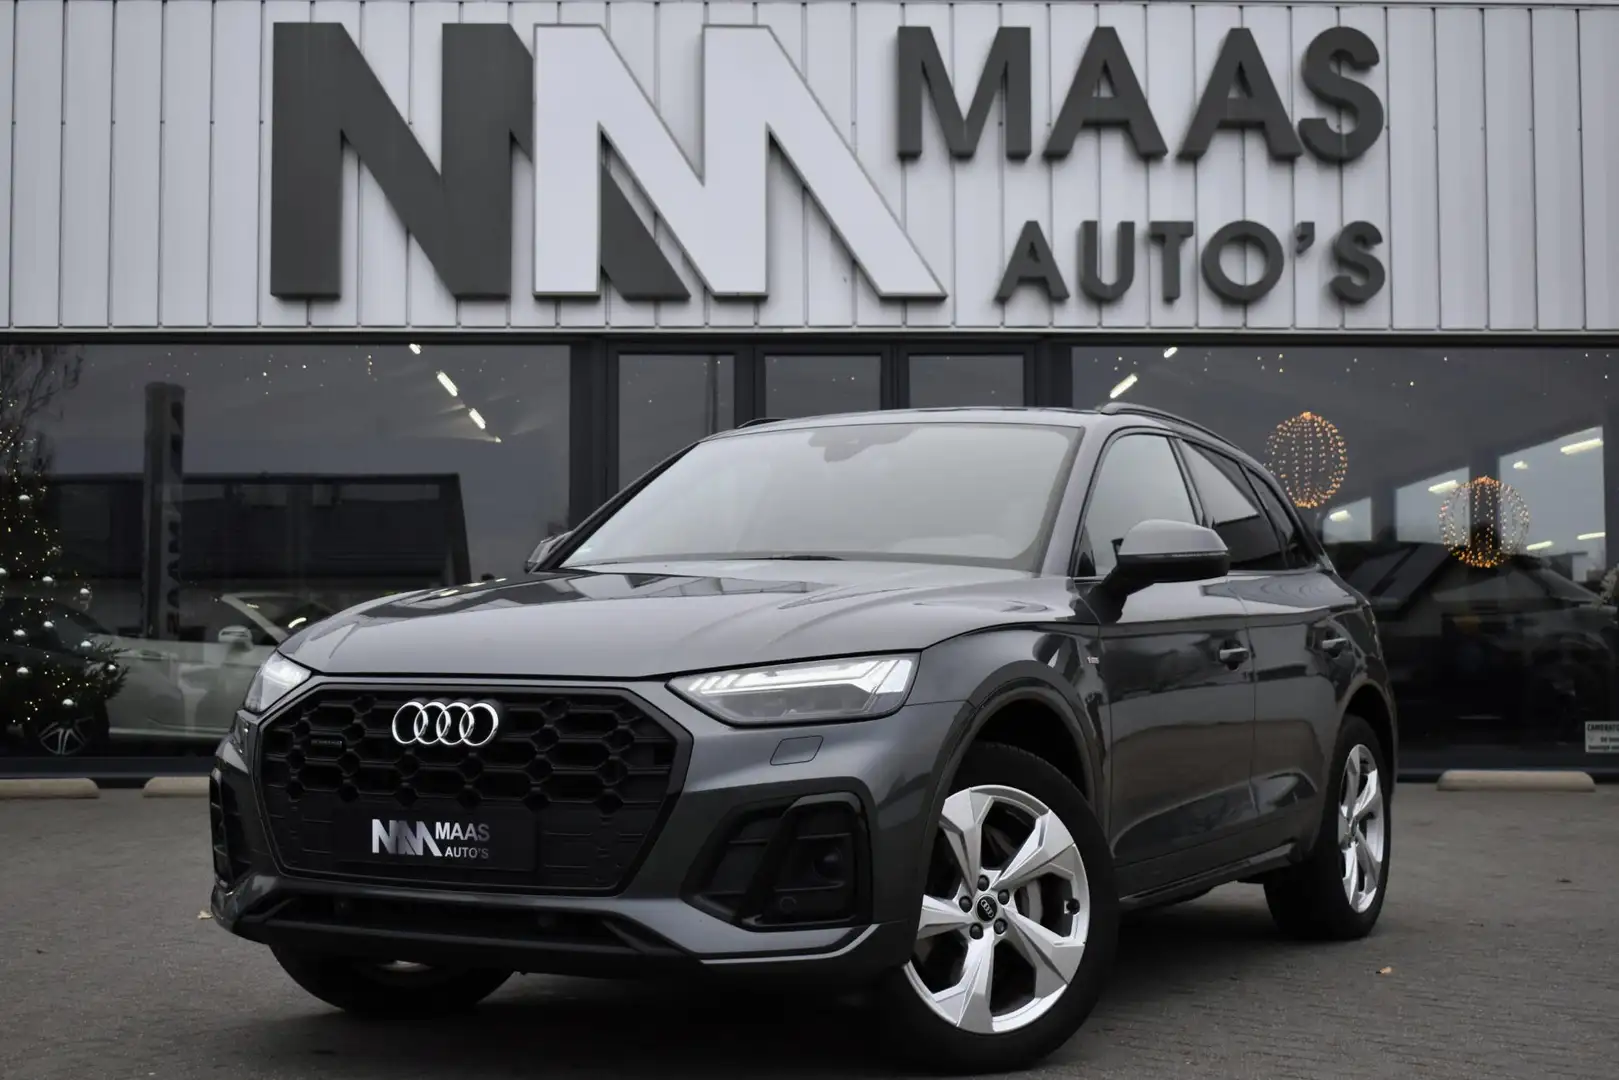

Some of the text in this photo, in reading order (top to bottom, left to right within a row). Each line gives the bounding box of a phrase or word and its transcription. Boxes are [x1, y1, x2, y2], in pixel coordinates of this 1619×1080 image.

[896, 25, 1384, 162] MAAS
[994, 219, 1386, 303] AUTO'S
[436, 821, 491, 842] MAAS
[445, 846, 490, 859] AUTO'S
